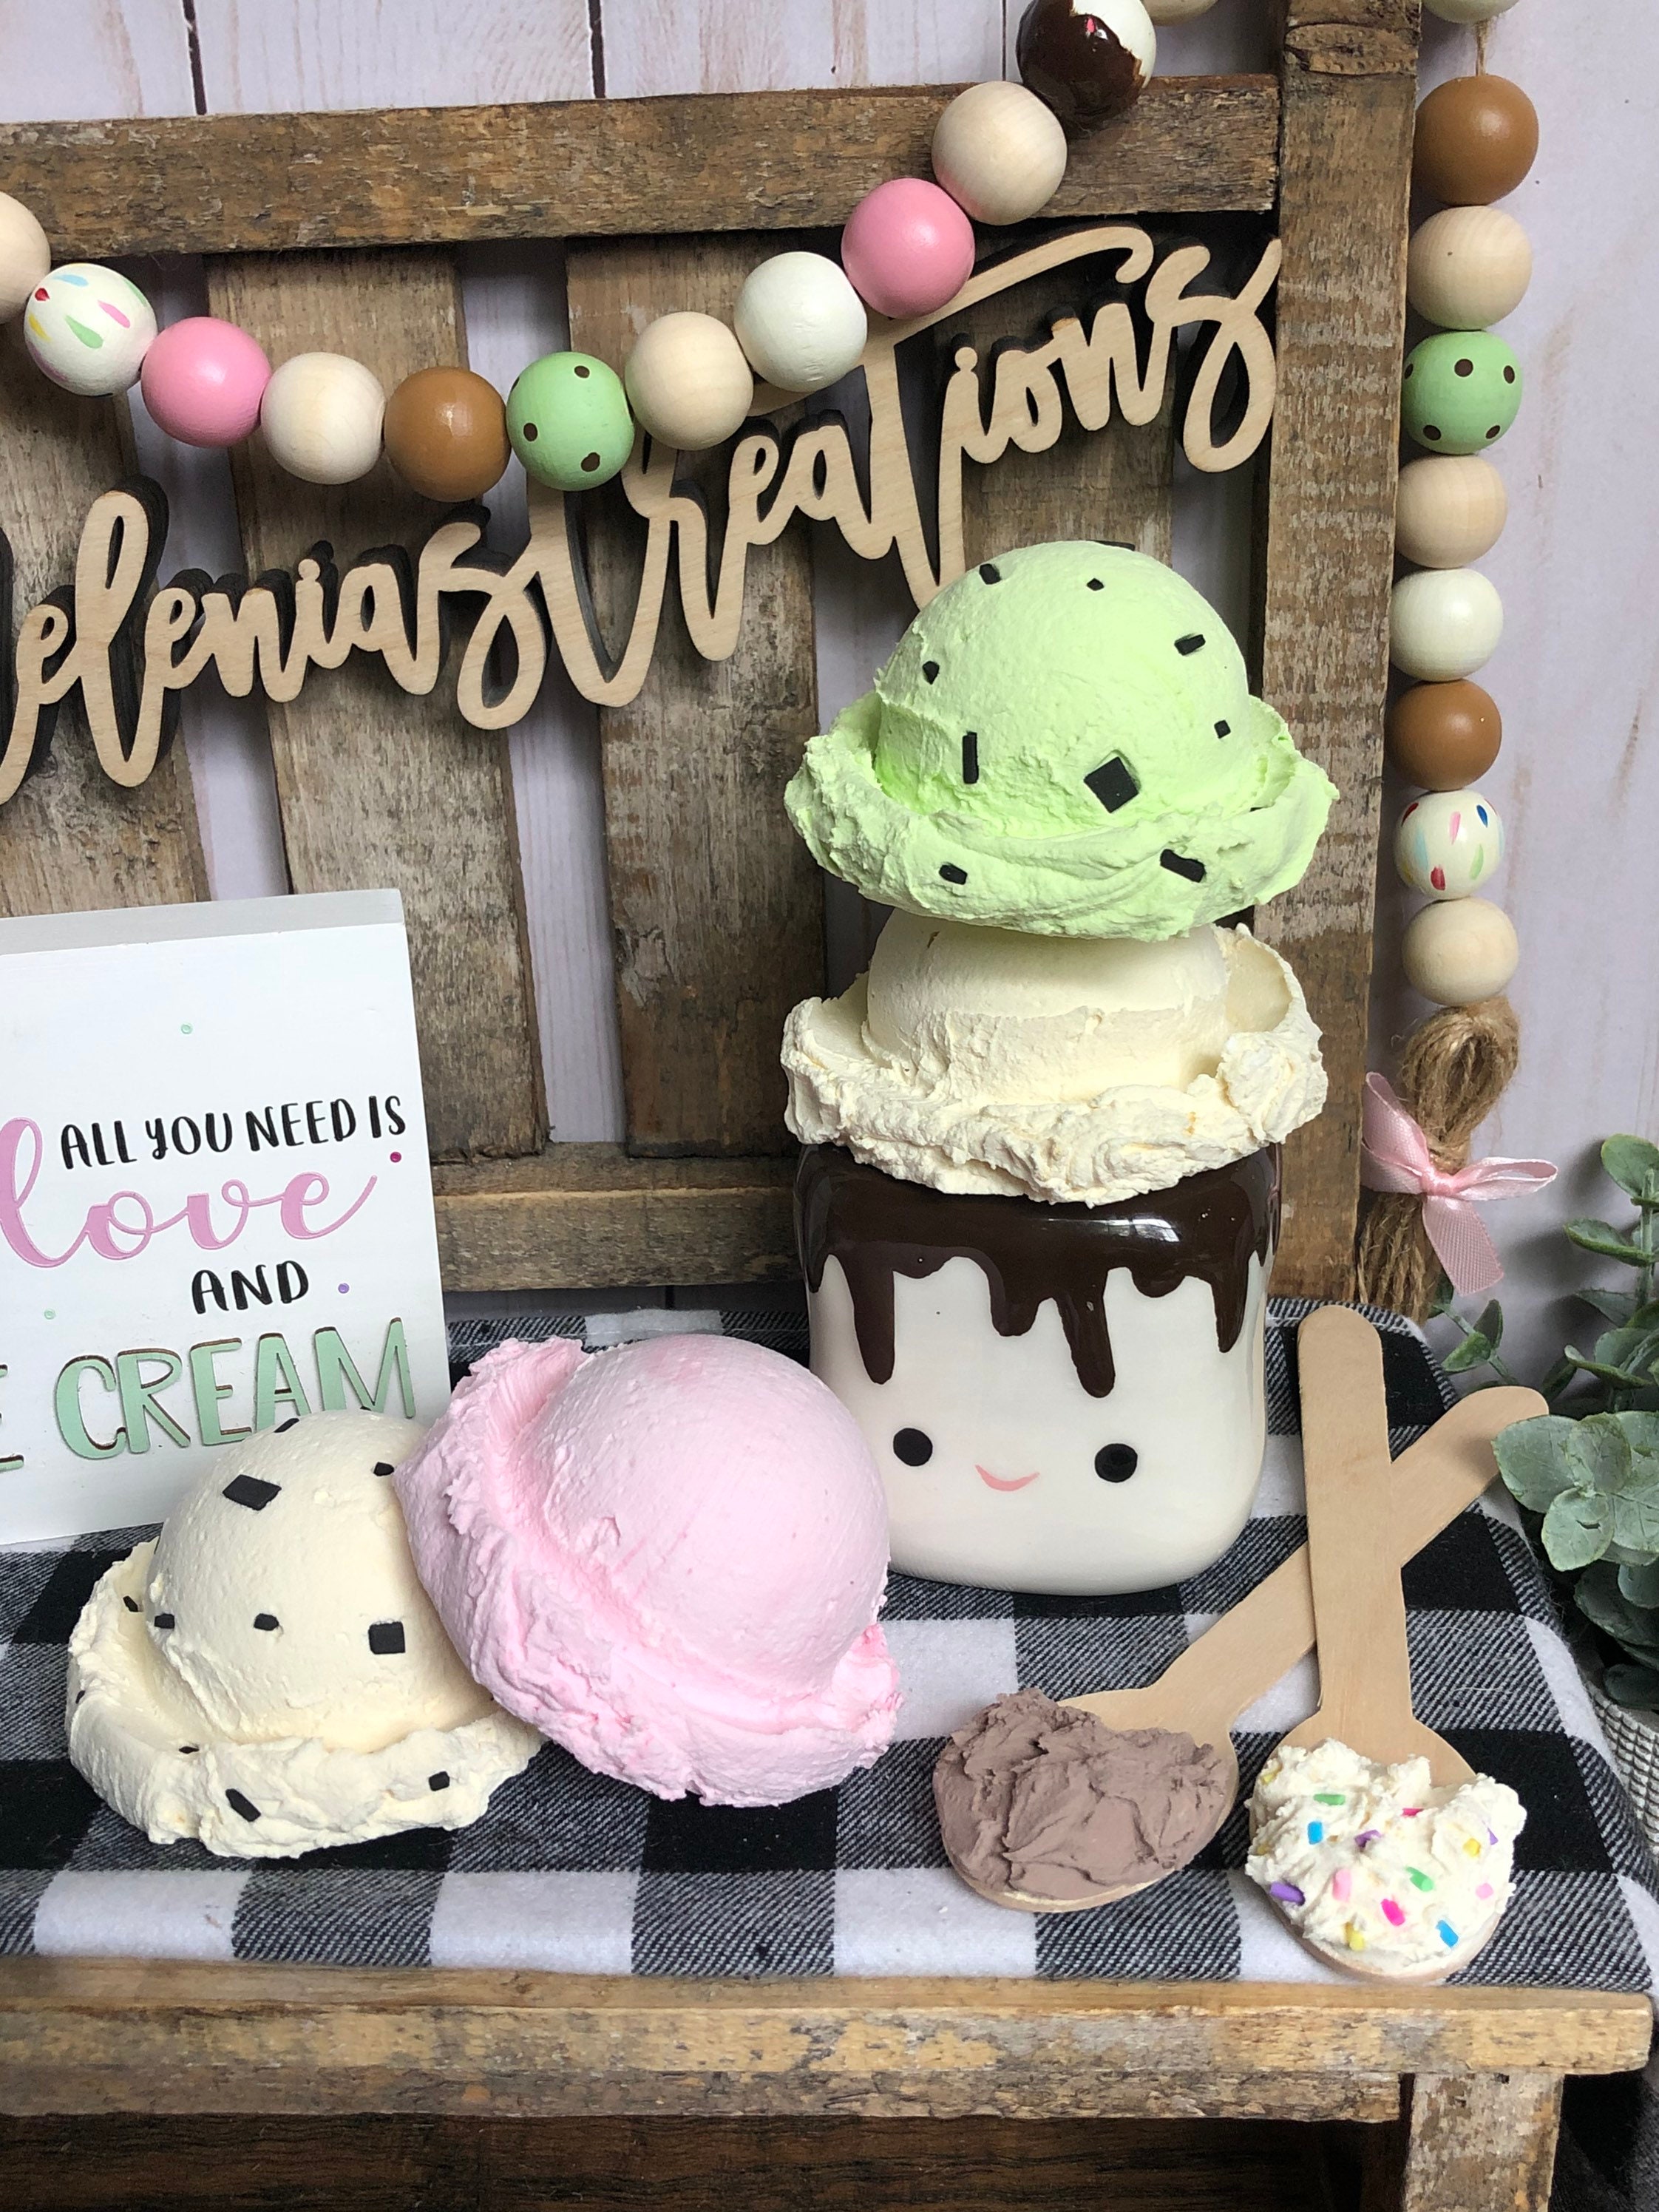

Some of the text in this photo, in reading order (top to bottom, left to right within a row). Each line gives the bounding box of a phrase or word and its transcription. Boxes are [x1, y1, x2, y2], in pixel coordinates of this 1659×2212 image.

[61, 1120, 137, 1170] ALL
[245, 1098, 356, 1152] NEED
[369, 1095, 406, 1139] IS
[0, 1117, 378, 1268] love
[191, 1260, 309, 1314] AND
[54, 1317, 416, 1459] CREAM
